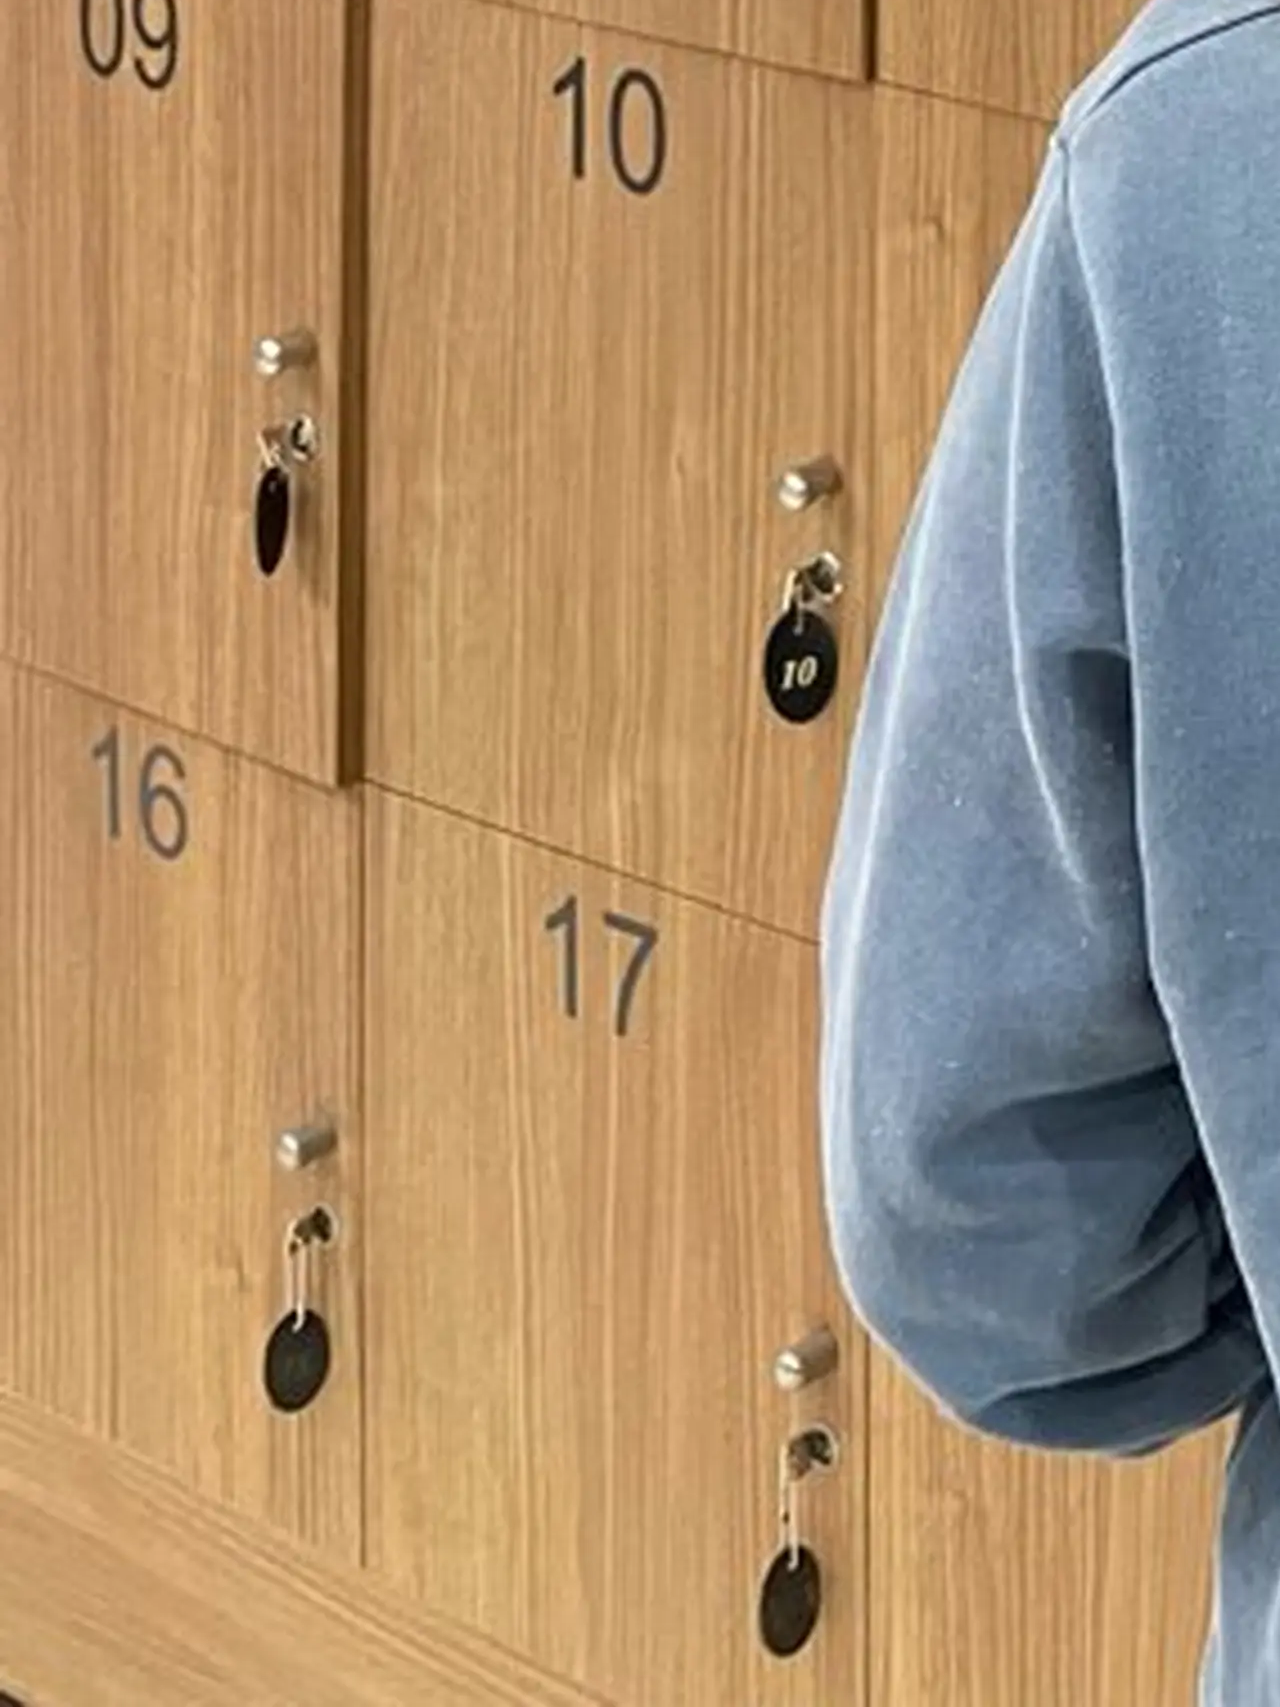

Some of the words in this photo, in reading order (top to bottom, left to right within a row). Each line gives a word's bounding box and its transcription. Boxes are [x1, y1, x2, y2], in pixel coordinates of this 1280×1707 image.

[552, 55, 667, 195] 10
[781, 655, 819, 691] 10
[92, 724, 188, 861] 16
[544, 894, 659, 1037] 17
